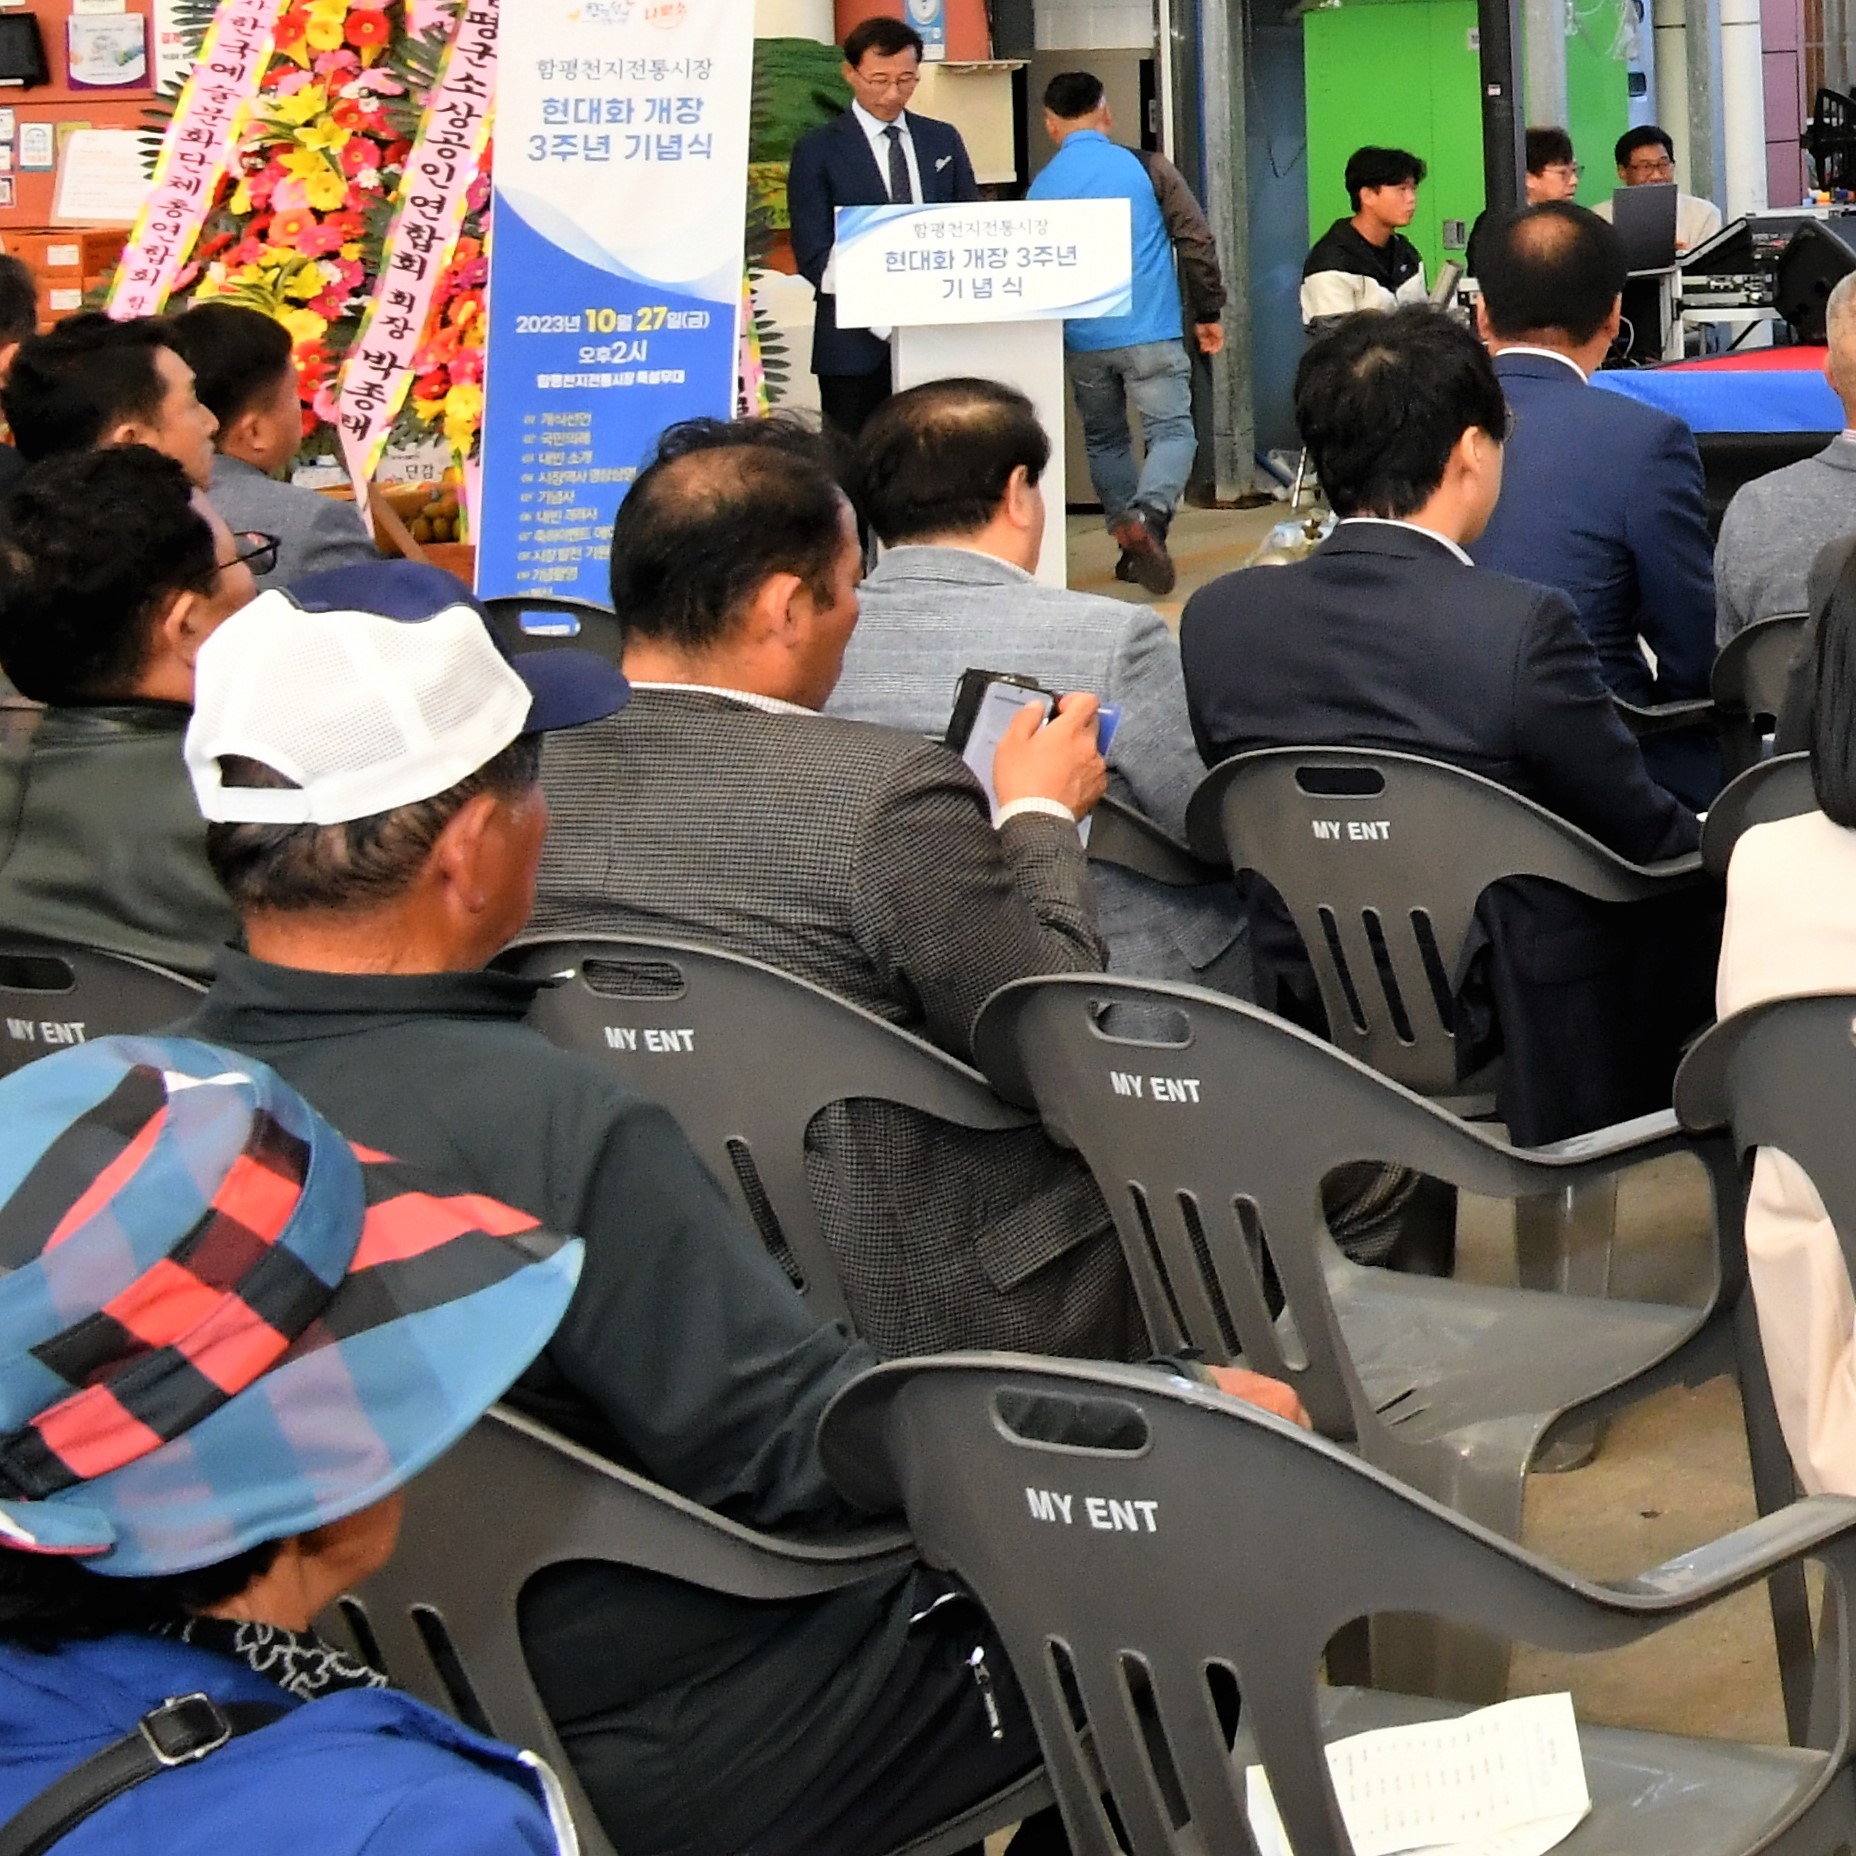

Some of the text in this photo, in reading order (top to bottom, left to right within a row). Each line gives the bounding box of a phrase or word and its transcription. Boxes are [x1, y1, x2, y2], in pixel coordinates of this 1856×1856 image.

[535, 57, 714, 82] 함평천지전통시장
[541, 96, 705, 126] 현대화 개장
[527, 131, 714, 163] 3주년 기념식
[912, 218, 1050, 240] 함평천지전통시장
[884, 244, 1079, 273] 현대화 개장 3주년
[378, 288, 416, 341] 회장
[514, 314, 581, 335] 2023년
[339, 348, 405, 442] 박종태
[1311, 820, 1391, 841] MY ENT
[5, 1017, 86, 1044] MY ENT
[603, 1025, 696, 1052] MY ENT
[1109, 1070, 1201, 1104] MY ENT
[1024, 1487, 1160, 1533] MY ENT
